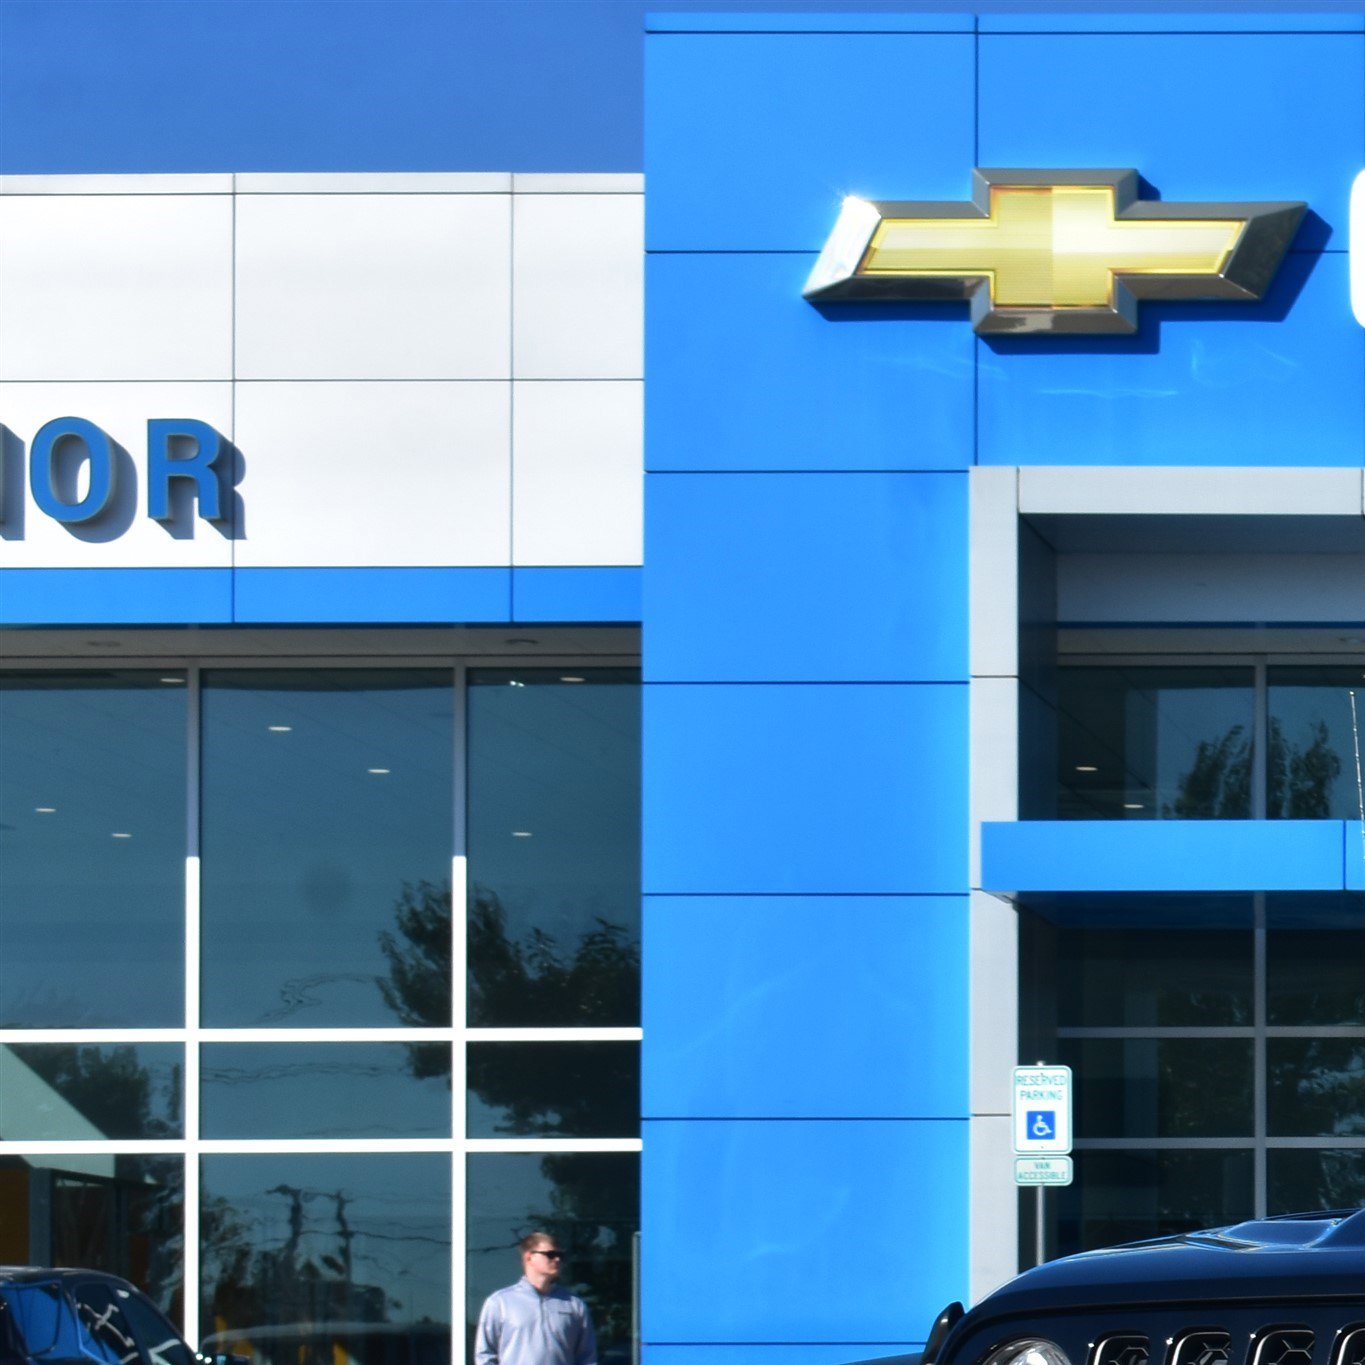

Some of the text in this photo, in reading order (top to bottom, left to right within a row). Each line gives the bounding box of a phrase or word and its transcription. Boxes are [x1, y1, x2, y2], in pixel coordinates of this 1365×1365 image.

[0, 416, 230, 528] OR
[1016, 1075, 1066, 1086] RESERVED
[1020, 1090, 1063, 1100] PARKING
[1034, 1162, 1051, 1170] VAN
[1018, 1172, 1066, 1180] ACCESSIBLE
